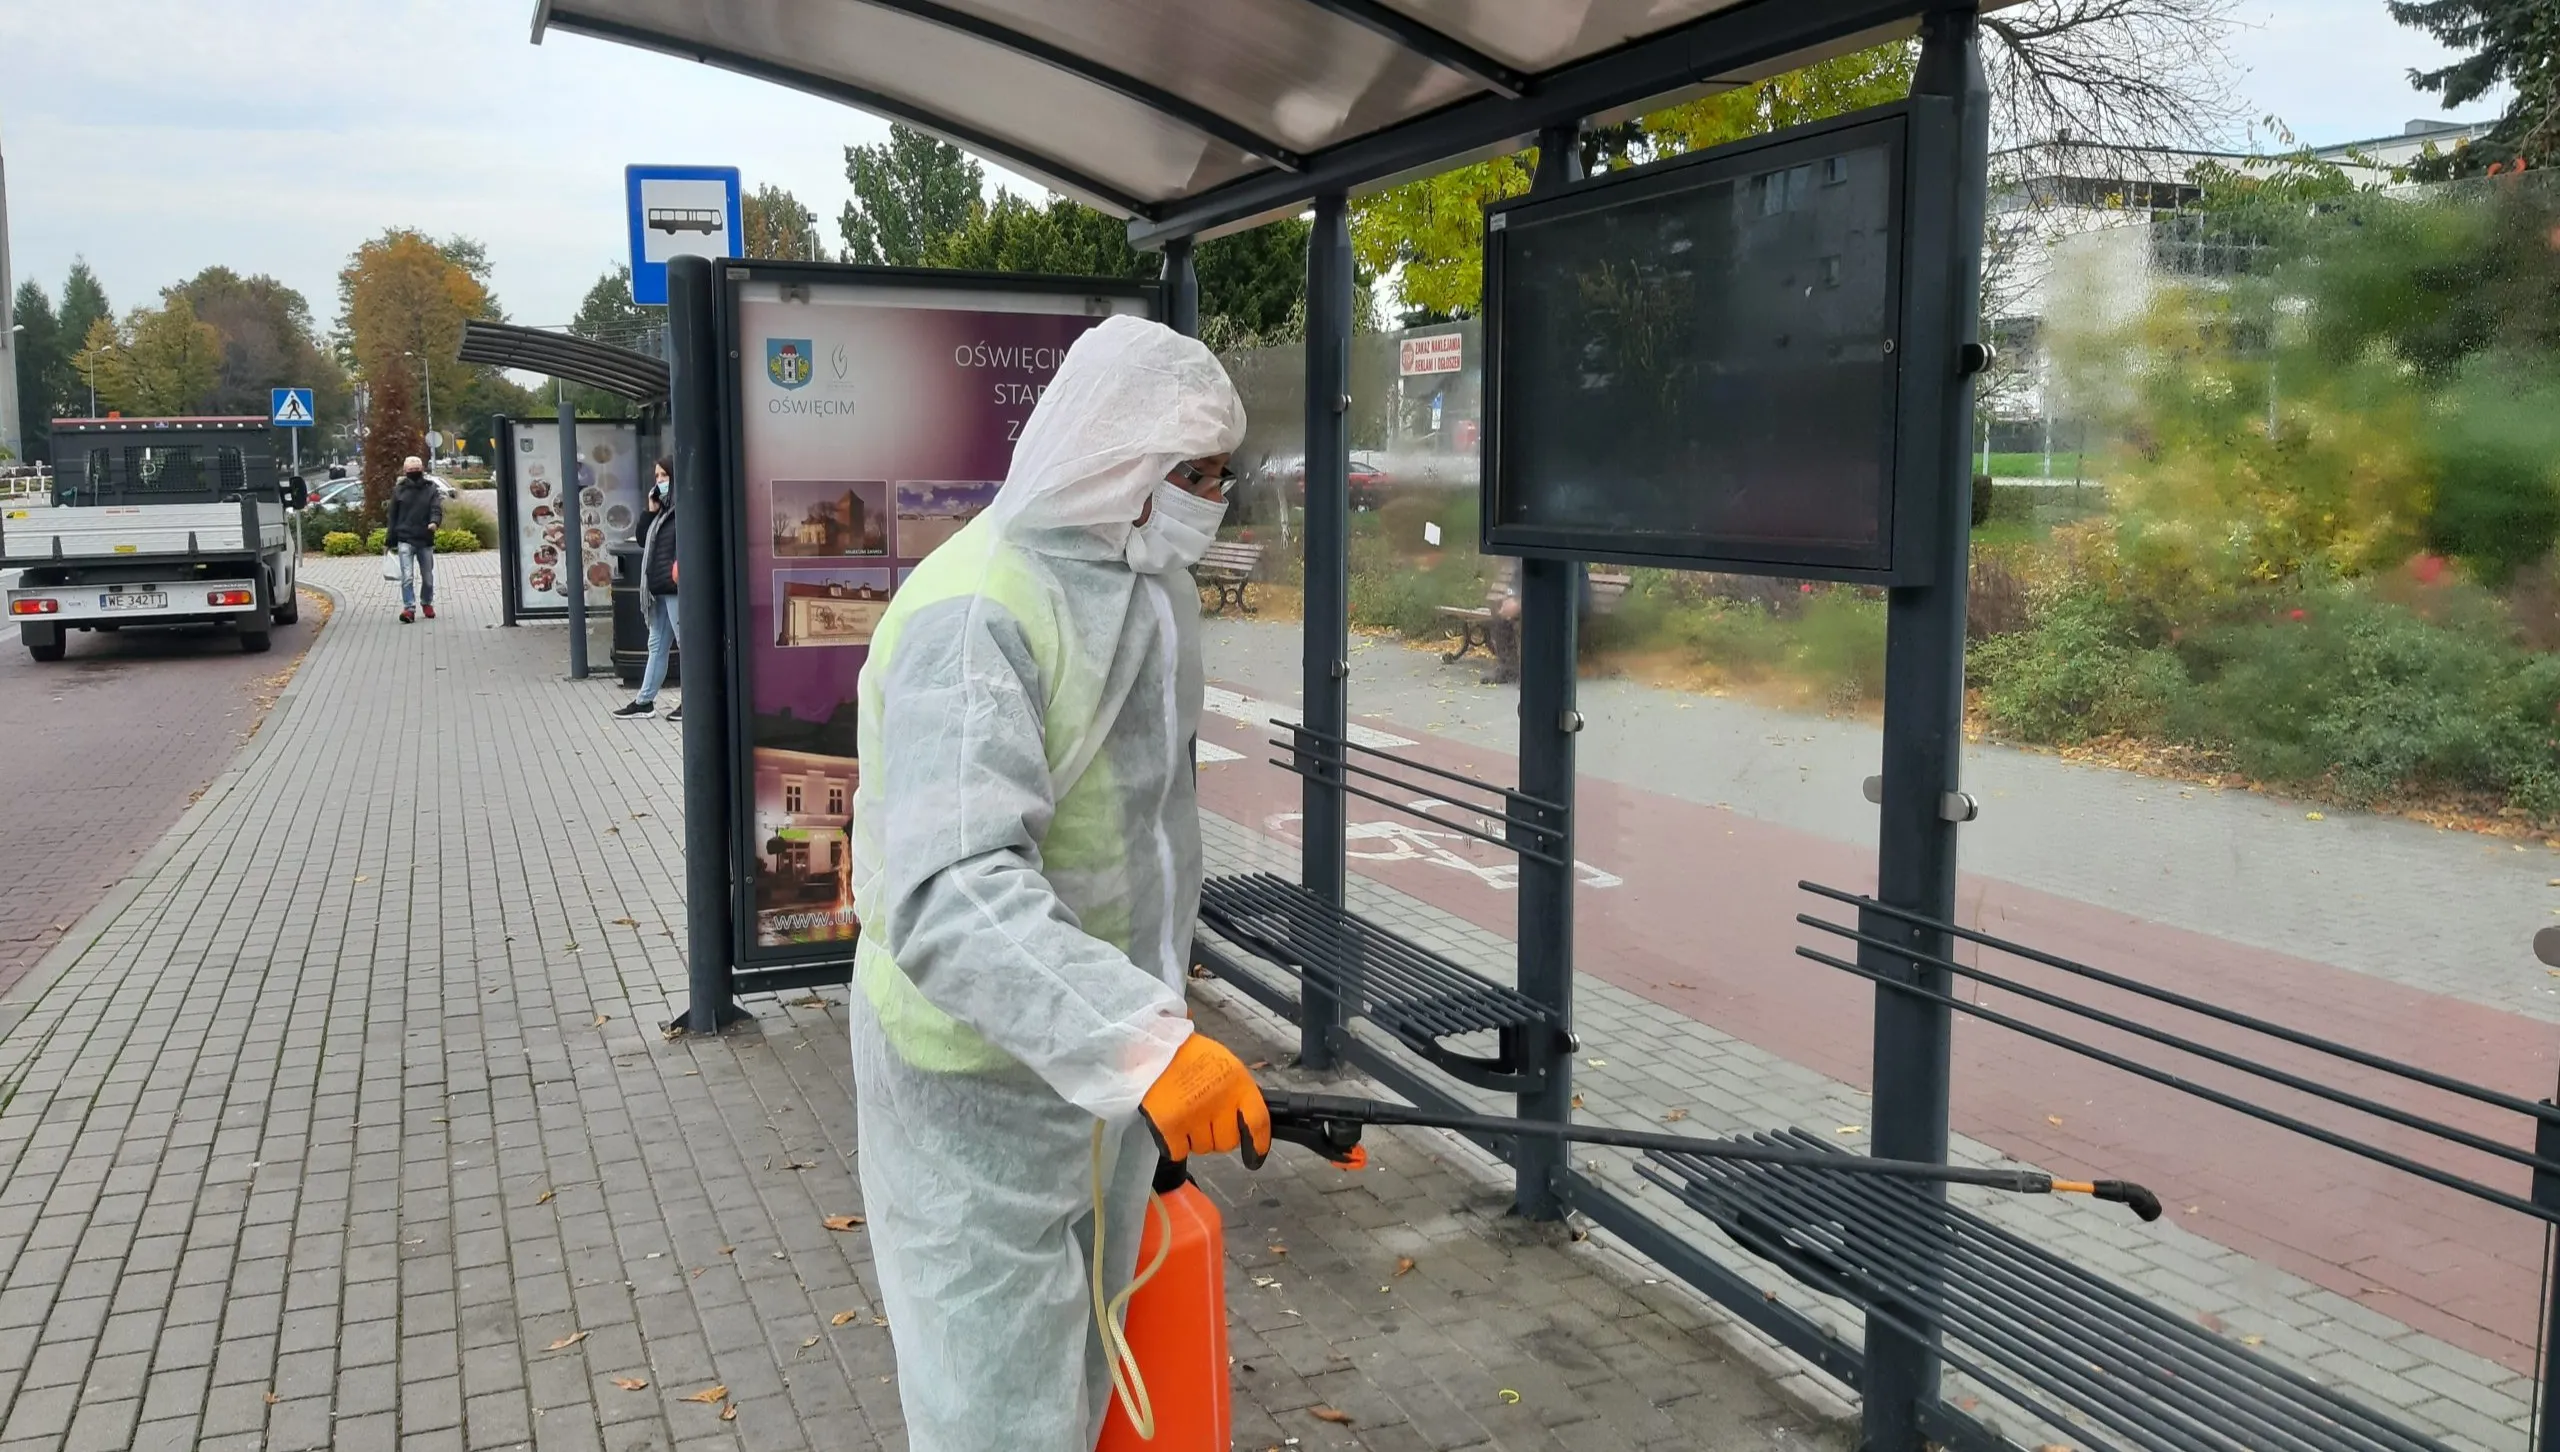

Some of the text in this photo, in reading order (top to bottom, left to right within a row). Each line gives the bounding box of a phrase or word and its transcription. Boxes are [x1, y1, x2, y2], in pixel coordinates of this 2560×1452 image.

[1415, 338, 1460, 355] ZAKAZ NAKLEJANIA
[1415, 358, 1433, 372] REKLAM
[768, 396, 855, 418] OŚWIĘCIM
[108, 594, 163, 607] WE 342TT
